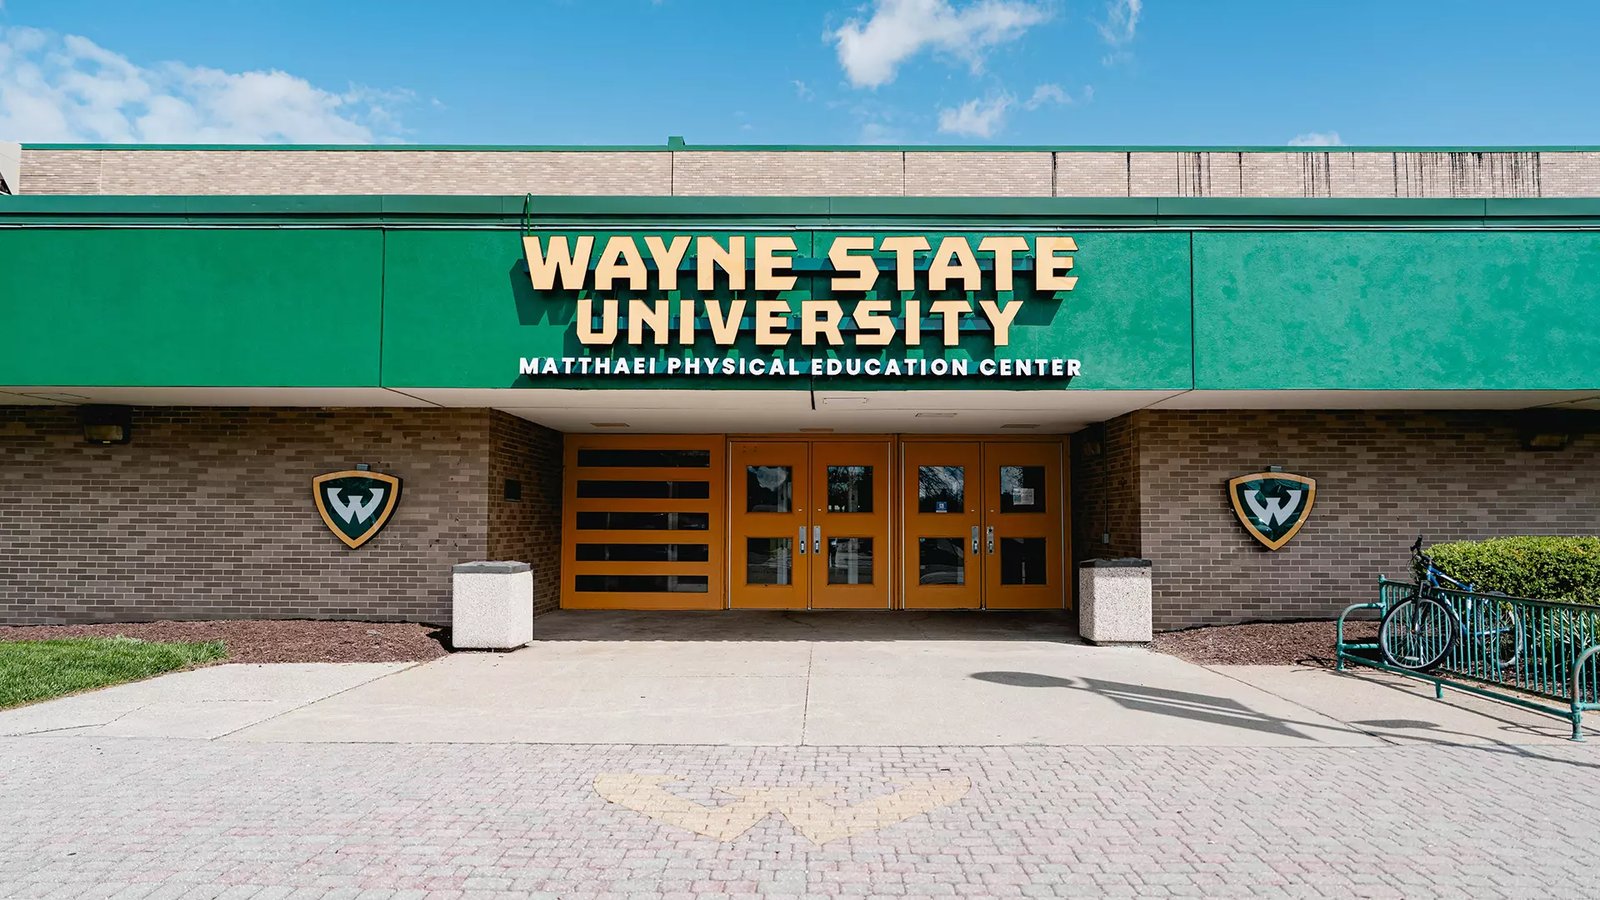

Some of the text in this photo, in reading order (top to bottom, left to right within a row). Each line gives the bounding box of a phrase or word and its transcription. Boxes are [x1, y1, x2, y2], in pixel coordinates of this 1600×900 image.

[523, 236, 1078, 291] WAYNE STATE
[577, 300, 1024, 346] UNIVERSITY
[519, 357, 1082, 377] MATTHAEI PHYSICAL EDUCATION CENTER
[327, 487, 385, 525] W
[1244, 489, 1302, 526] W
